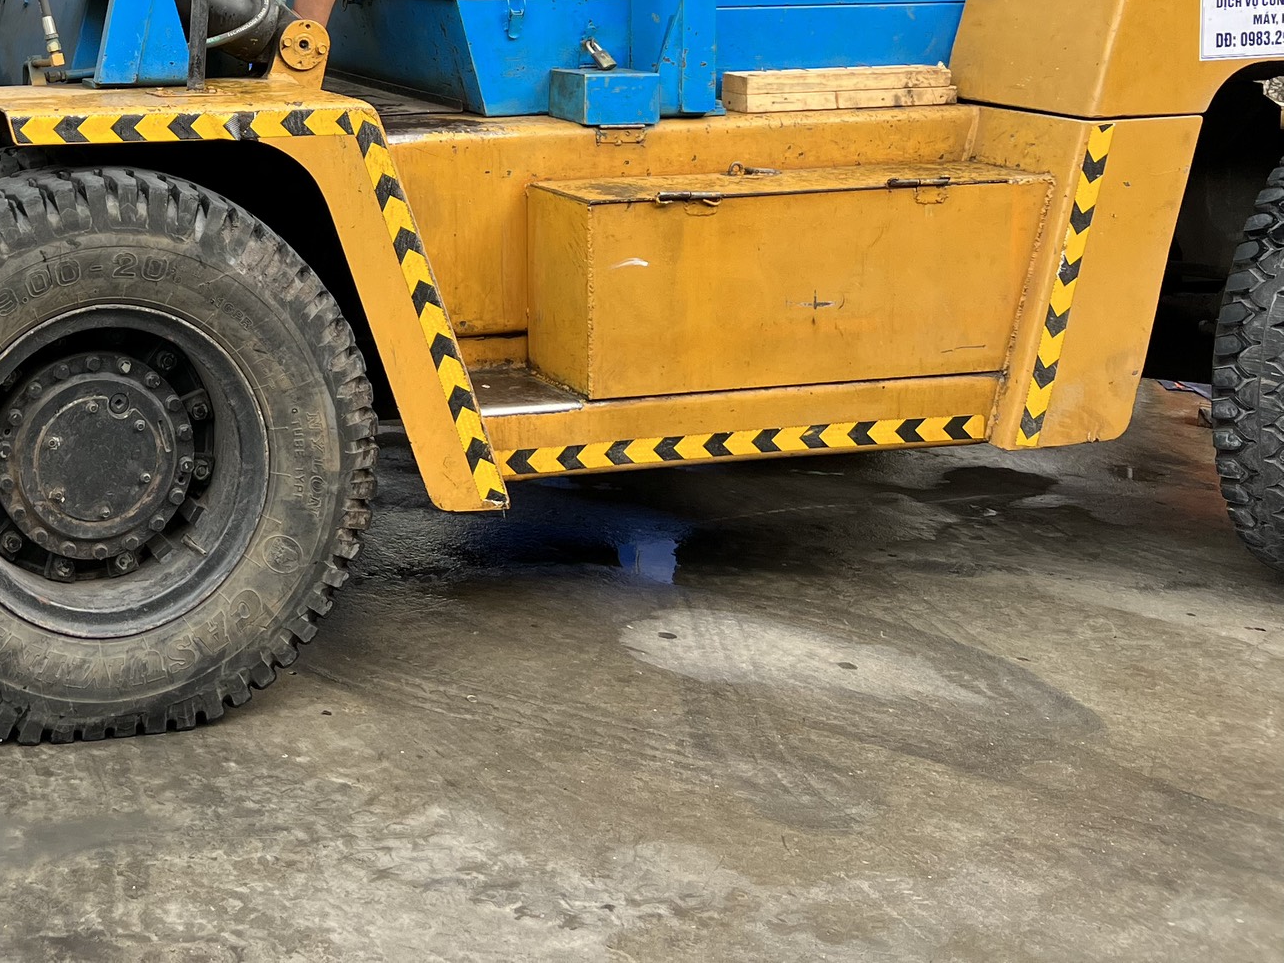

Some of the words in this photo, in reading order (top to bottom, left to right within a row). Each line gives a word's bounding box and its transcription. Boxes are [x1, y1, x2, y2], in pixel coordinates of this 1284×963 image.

[1253, 11, 1279, 26] MÁY,
[1216, 31, 1237, 48] DĐ:
[1240, 29, 1284, 47] 0983.2
[306, 410, 326, 518] NYLON
